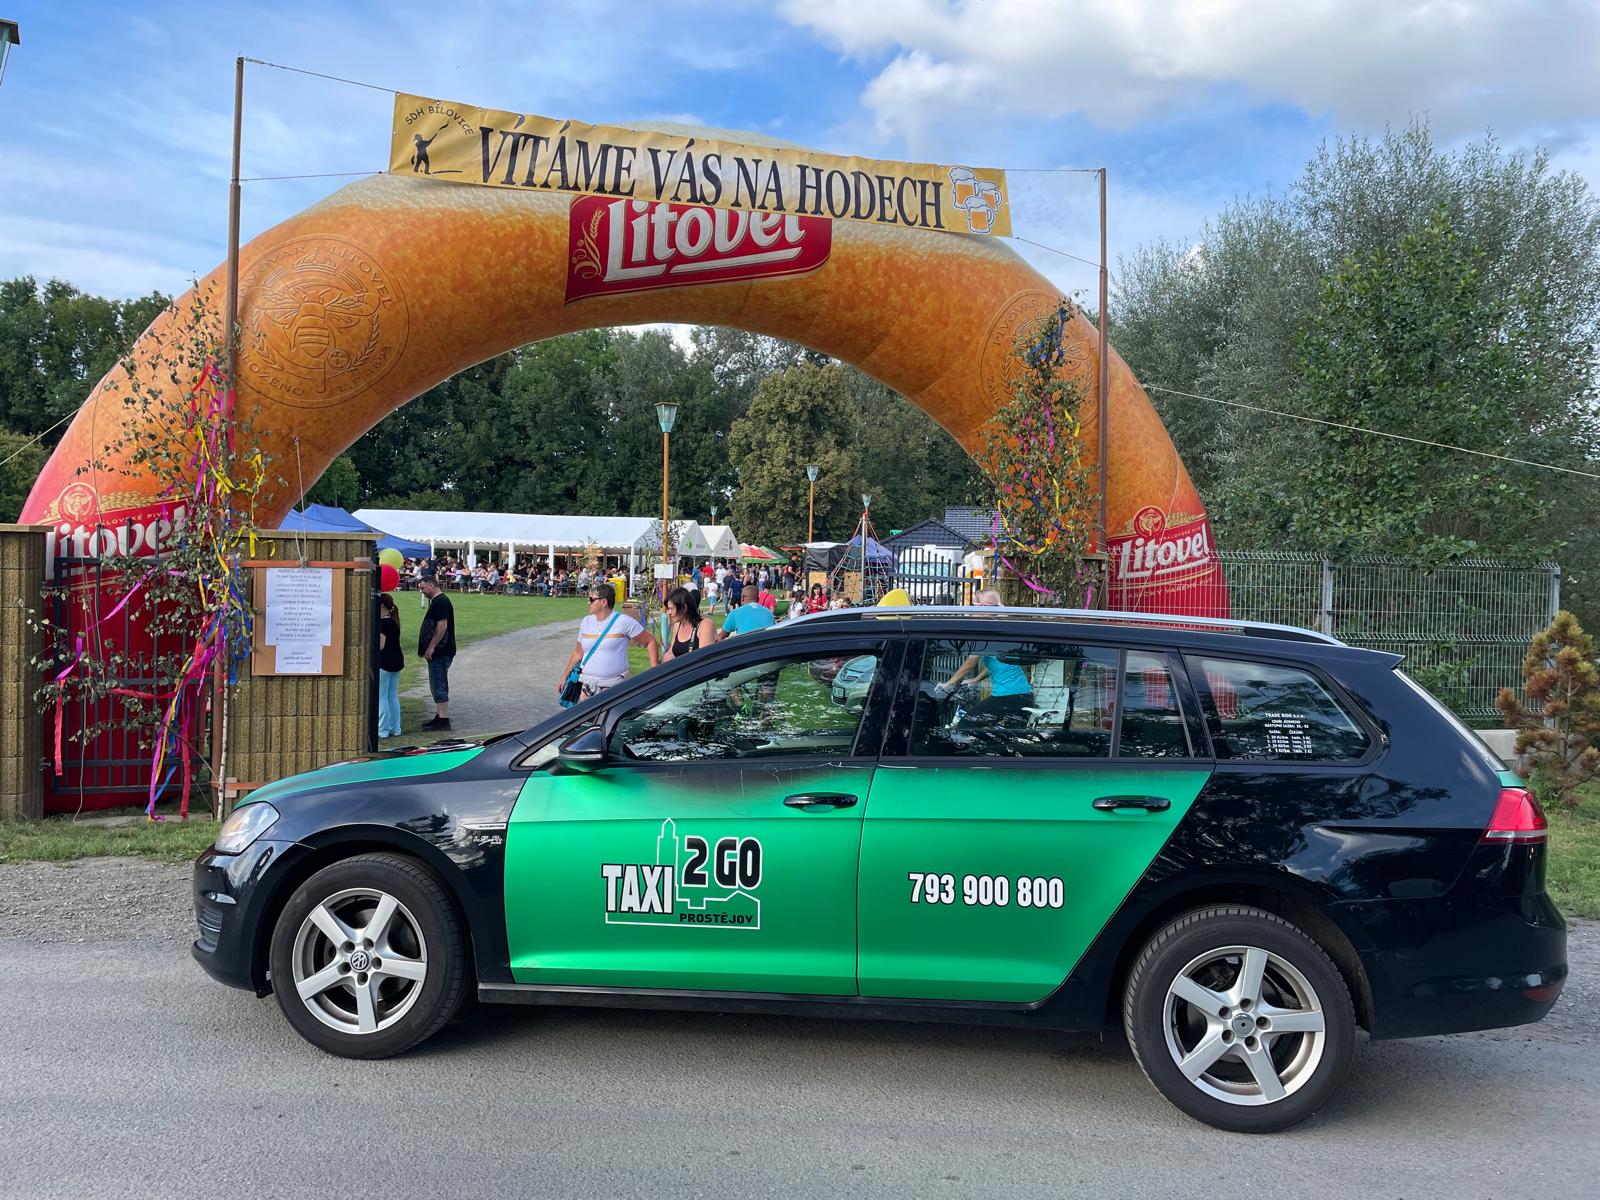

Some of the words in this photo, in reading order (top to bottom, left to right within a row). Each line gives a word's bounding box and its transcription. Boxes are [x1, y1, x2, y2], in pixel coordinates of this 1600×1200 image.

[404, 107, 425, 125] SDH
[428, 103, 476, 136] BÍLOVICE
[479, 115, 637, 197] VÍTÁME
[647, 138, 723, 206] VÁS
[730, 157, 786, 212] NA
[795, 164, 946, 230] HODECH
[328, 246, 393, 309] LITOVEL
[239, 346, 305, 396] LOŽENO
[1117, 522, 1210, 579] Litovel
[682, 835, 709, 888] 2
[714, 836, 763, 890] GO
[601, 863, 675, 915] TAXI
[908, 872, 956, 905] 793
[962, 873, 1010, 907] 900
[1016, 875, 1065, 909] 800
[679, 911, 754, 925] PROSTĚJOV
